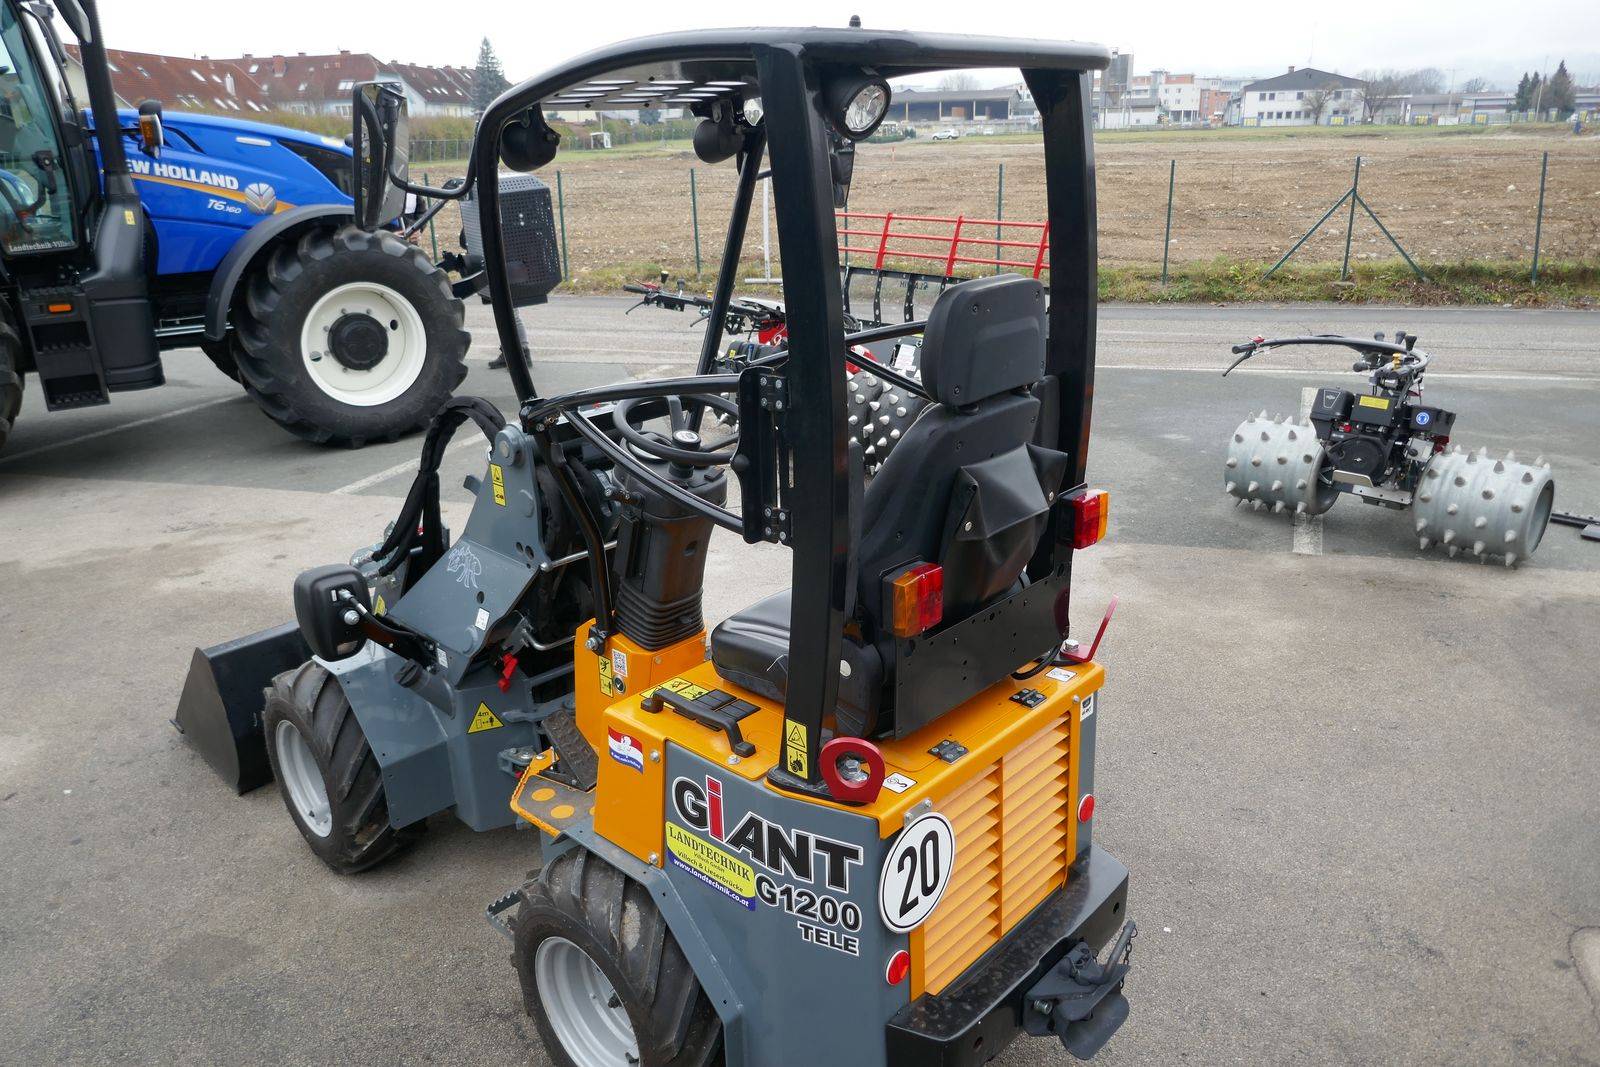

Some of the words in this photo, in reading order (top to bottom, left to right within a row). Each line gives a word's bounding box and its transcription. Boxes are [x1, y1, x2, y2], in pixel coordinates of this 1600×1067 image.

[125, 158, 150, 175] EW
[153, 162, 239, 190] HOLLAND
[207, 198, 242, 214] T6.160
[669, 826, 751, 882] LANDTECHNIK
[677, 850, 698, 866] Villach
[897, 829, 940, 919] 20
[673, 858, 749, 907] www.landtechnik.co.at
[754, 873, 863, 933] G1200
[796, 921, 861, 957] TELE
